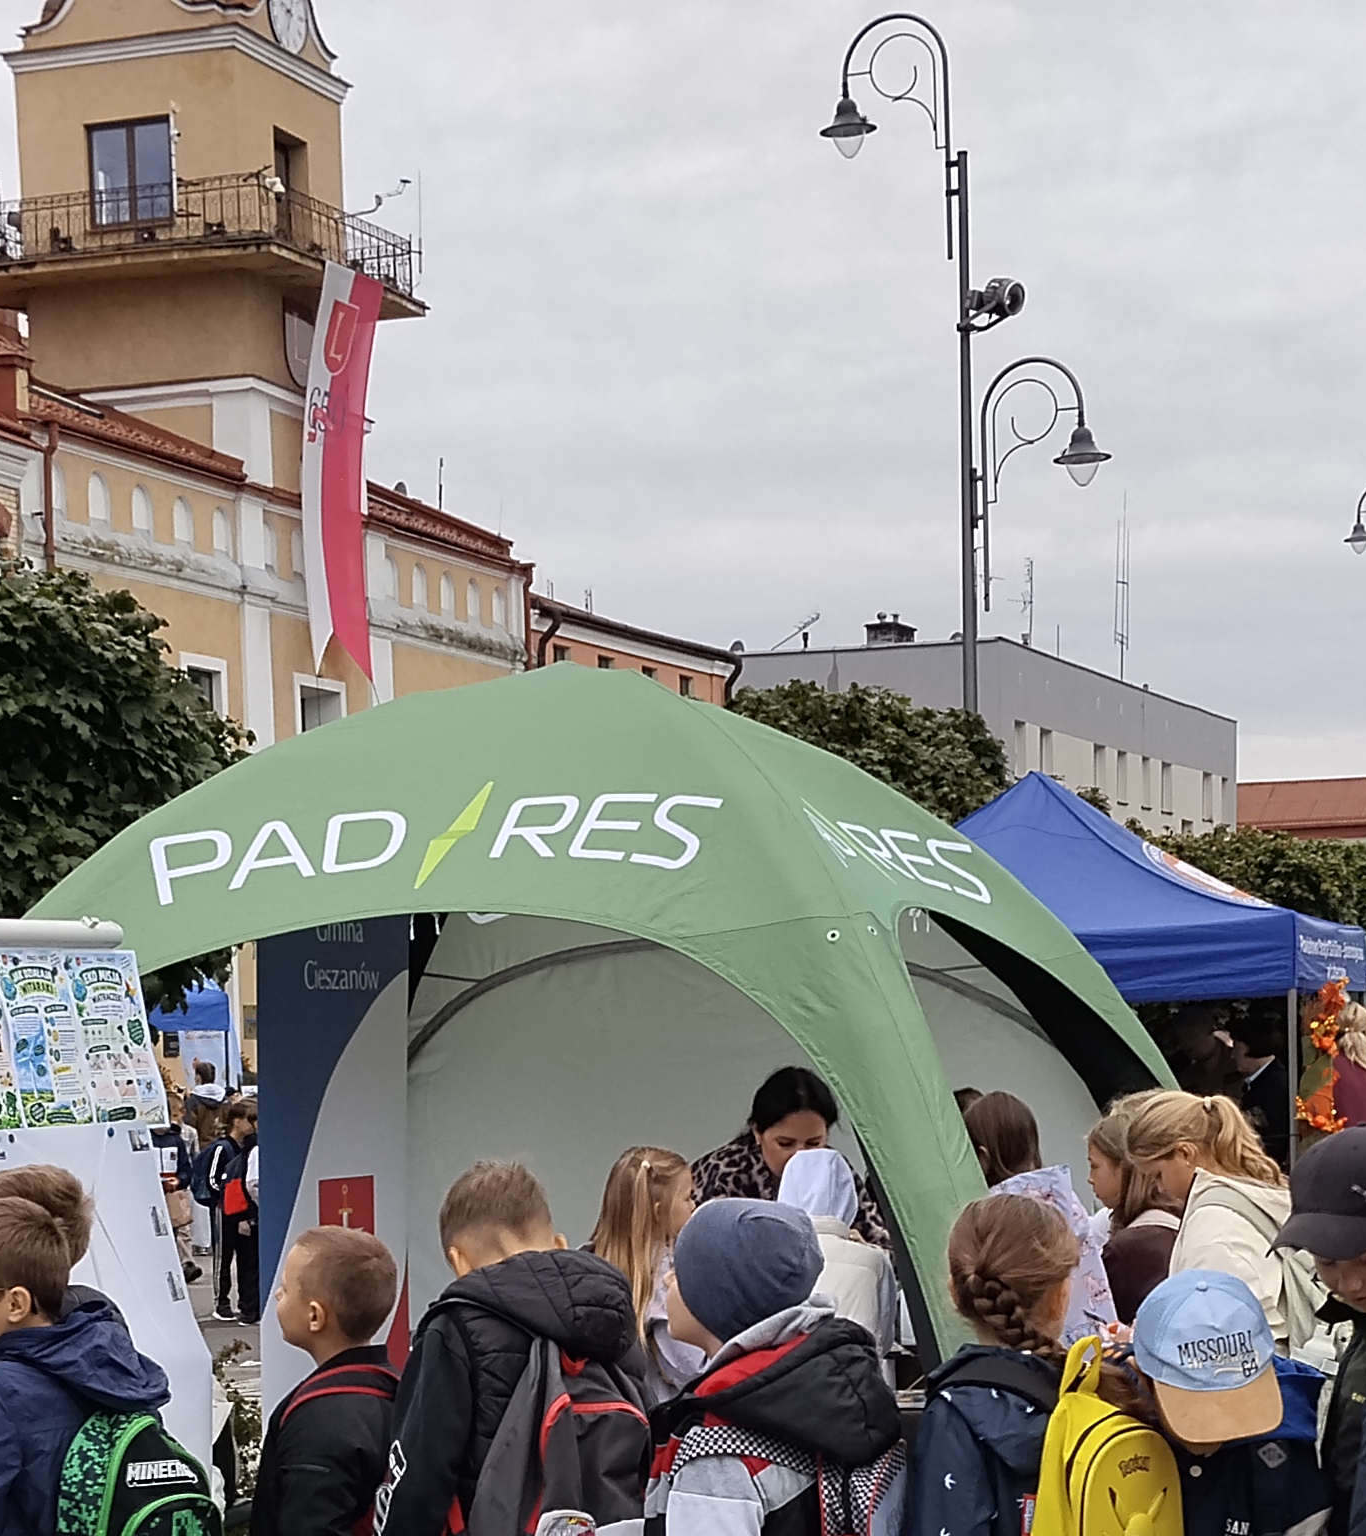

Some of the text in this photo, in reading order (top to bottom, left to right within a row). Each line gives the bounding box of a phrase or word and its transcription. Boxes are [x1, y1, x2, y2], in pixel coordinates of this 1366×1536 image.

[148, 810, 406, 906] PAD
[488, 793, 722, 869] RES
[304, 960, 380, 990] Cieszanów
[1177, 1330, 1254, 1366] MISSOURI
[1241, 1358, 1258, 1378] 64
